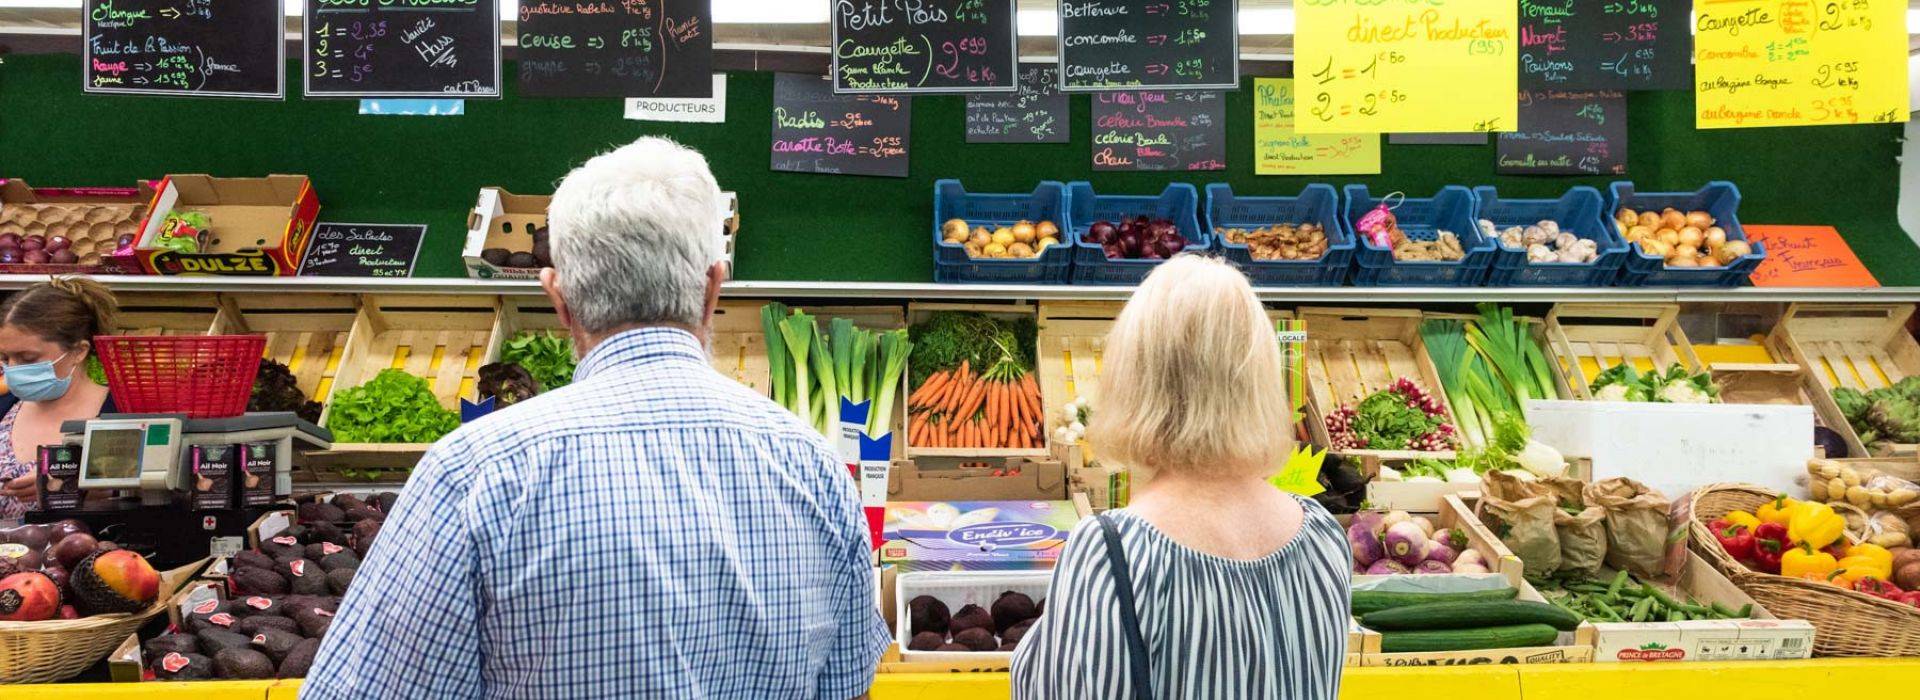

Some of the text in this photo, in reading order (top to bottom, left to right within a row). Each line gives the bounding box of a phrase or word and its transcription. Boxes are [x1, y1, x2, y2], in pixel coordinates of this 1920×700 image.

[837, 0, 893, 30] Petit
[895, 0, 948, 25] Pois
[1062, 1, 1128, 18] Betterave
[1347, 13, 1417, 43] direct
[1697, 7, 1775, 36] Courgette
[90, 34, 121, 54] Fruit
[124, 41, 138, 53] de
[1065, 29, 1137, 47] concombre
[1521, 24, 1568, 47] Navet
[837, 37, 920, 63] Courgette
[93, 61, 128, 75] Rouge
[314, 60, 328, 77] 3
[636, 101, 716, 113] PRODUCTEURS
[1311, 92, 1334, 122] 2
[774, 107, 825, 129] Radis
[181, 257, 268, 271] DULZE
[1618, 651, 1642, 659] PRINCE
[1649, 650, 1683, 659] BRETAGNE
